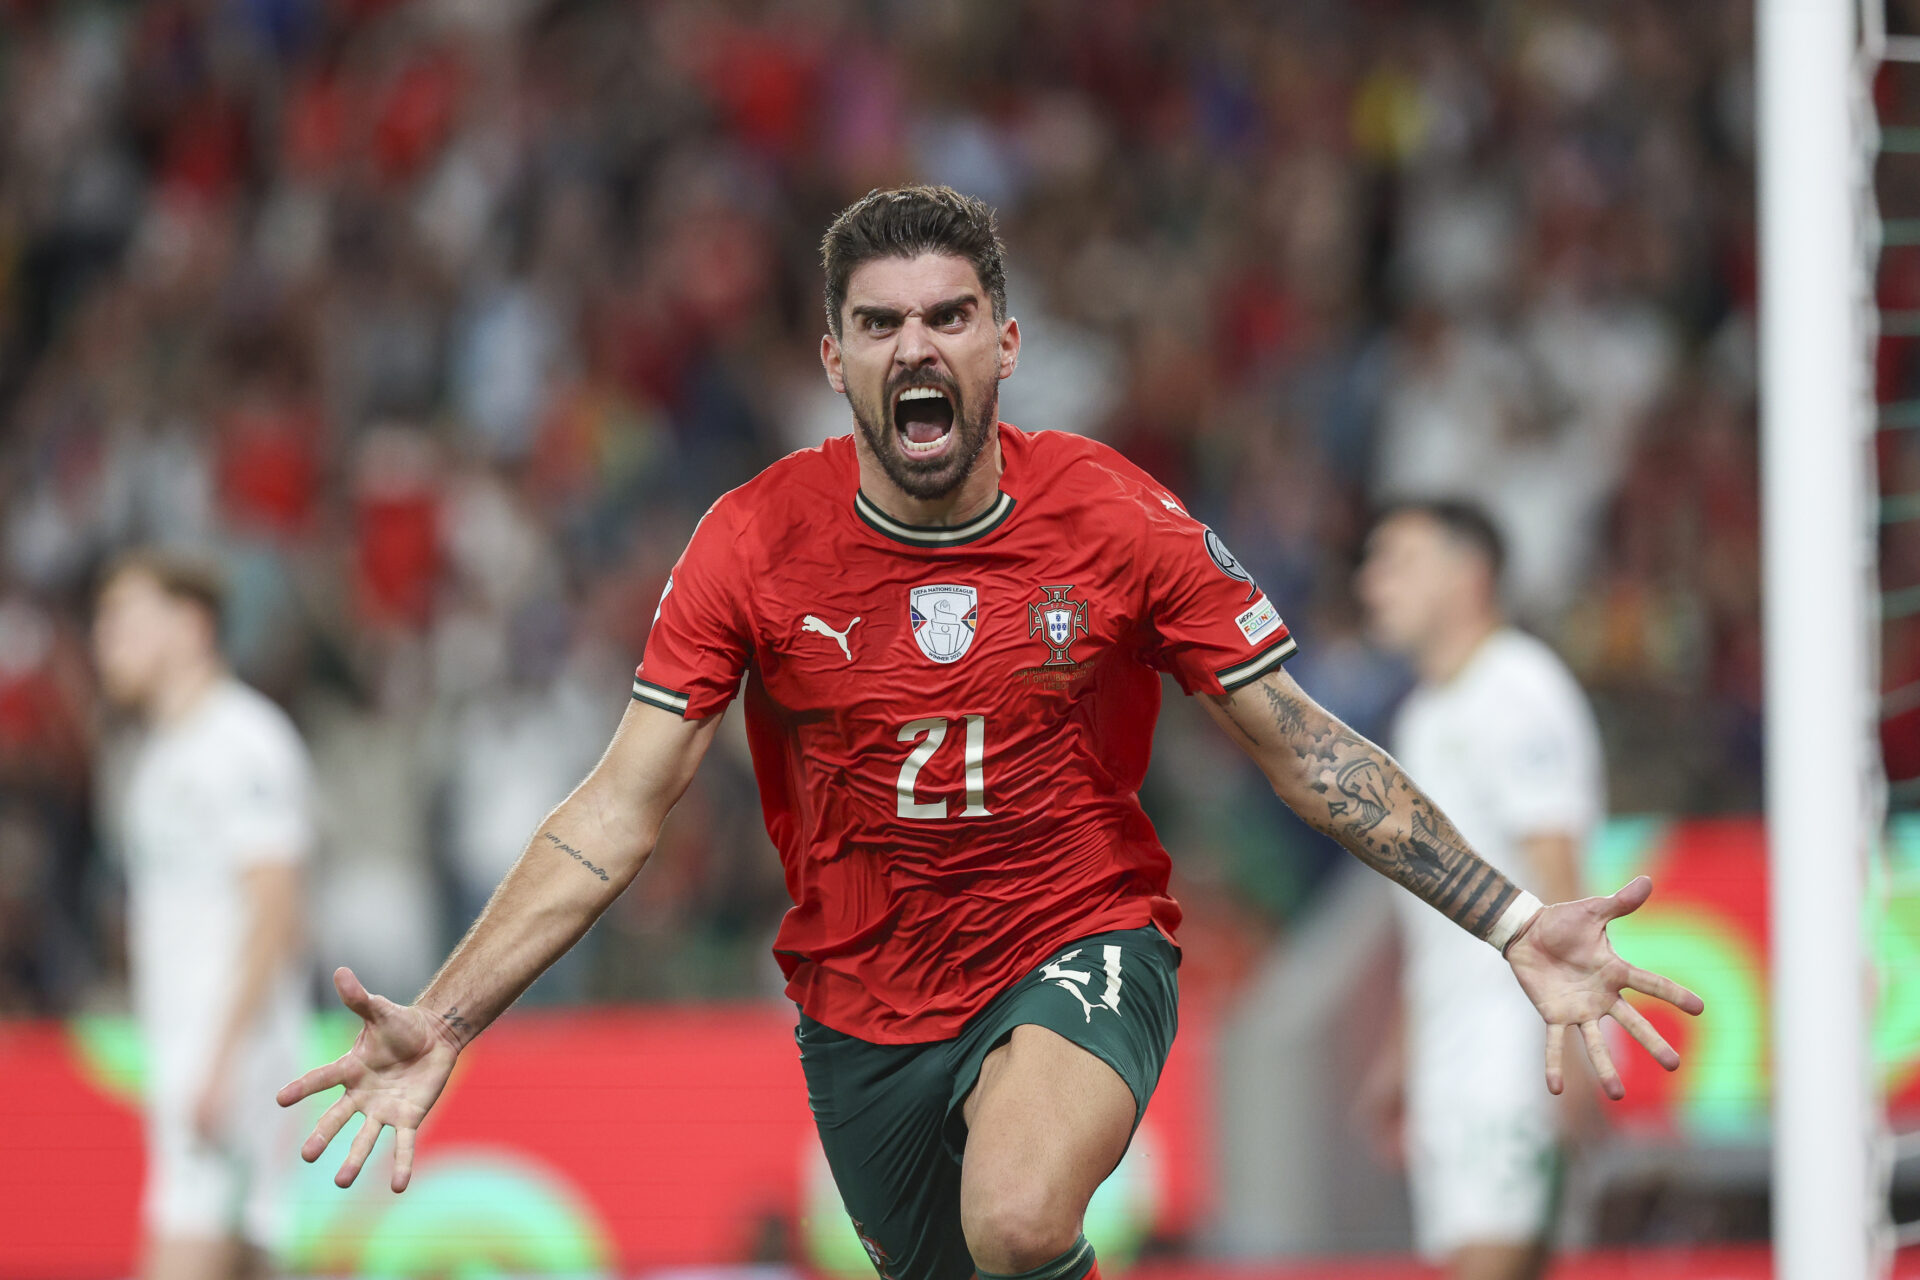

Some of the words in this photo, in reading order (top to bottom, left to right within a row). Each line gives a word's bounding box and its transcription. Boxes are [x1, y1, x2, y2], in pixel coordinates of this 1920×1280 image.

[952, 586, 974, 595] LEAGUE
[1238, 611, 1254, 624] UEFA
[928, 651, 950, 662] WINNER
[896, 714, 994, 819] 21
